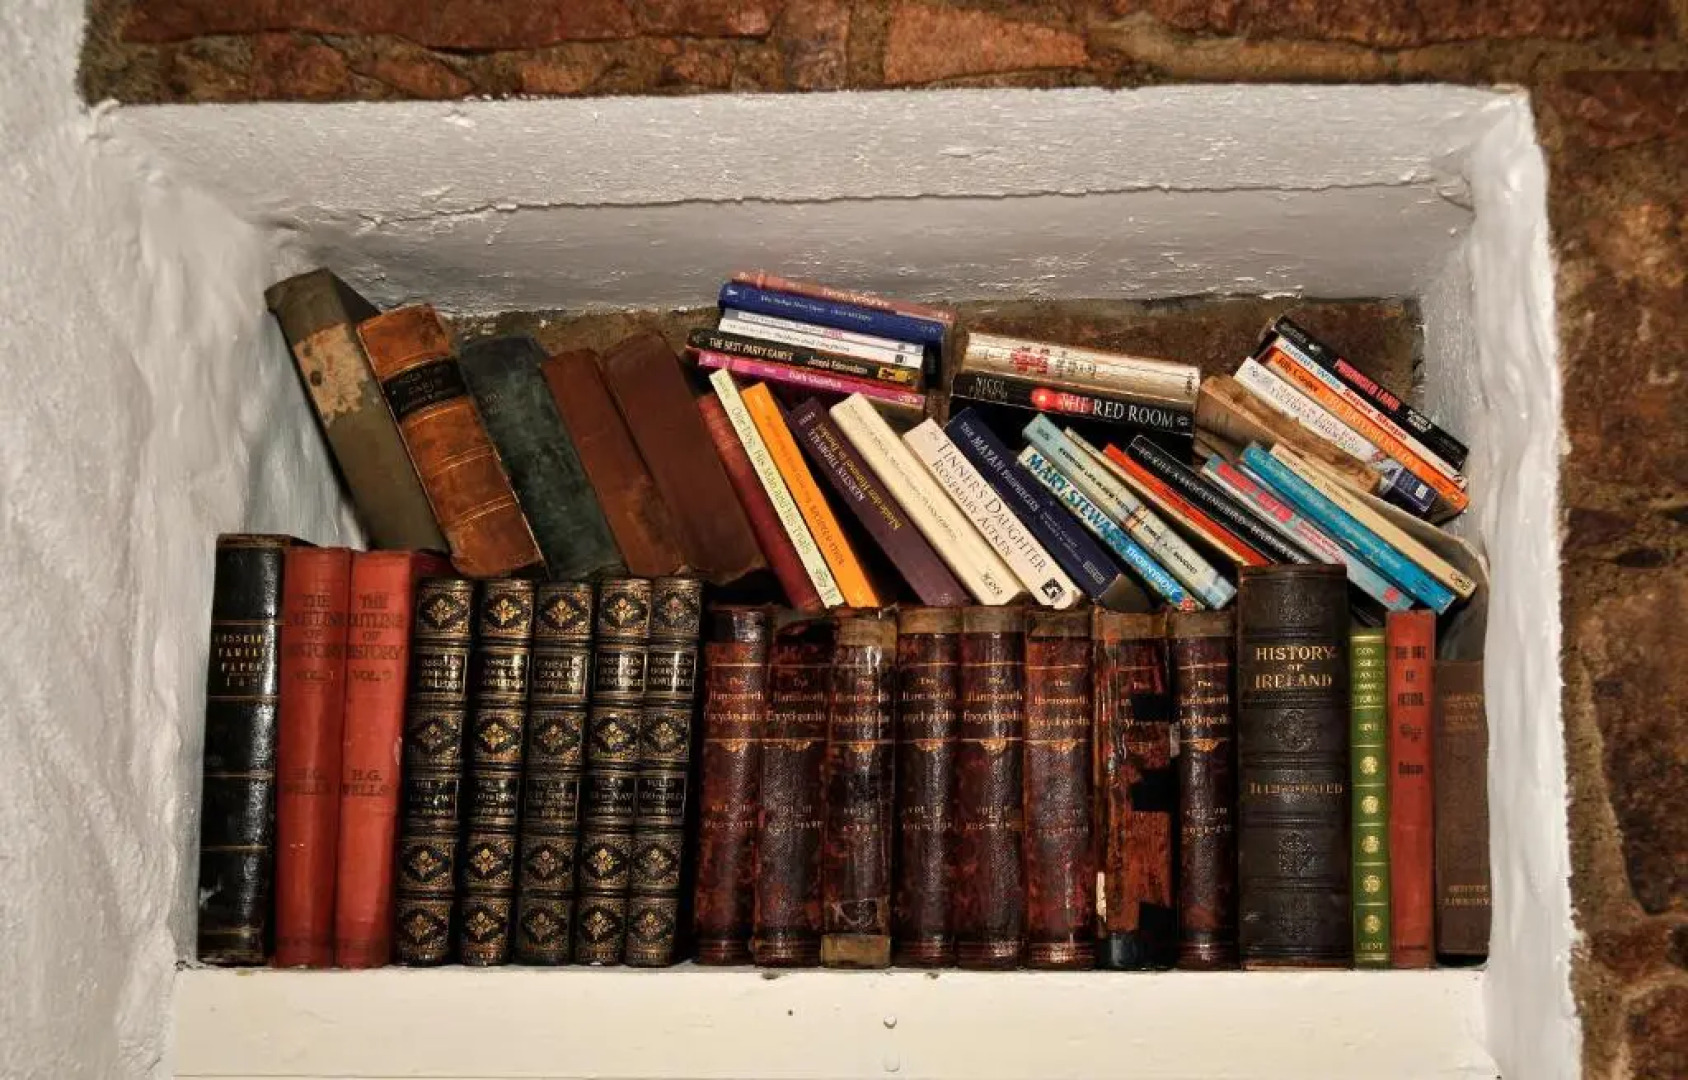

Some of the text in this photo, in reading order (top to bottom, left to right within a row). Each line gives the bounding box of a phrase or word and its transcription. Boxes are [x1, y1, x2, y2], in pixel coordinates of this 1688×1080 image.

[709, 337, 722, 348] THE
[723, 340, 742, 352] BEST
[742, 343, 767, 357] PARTY
[1059, 392, 1176, 428] THE RED ROOM
[1341, 387, 1375, 416] Super
[805, 426, 840, 469] THORVALL
[969, 433, 1006, 474] MAYAN
[1083, 469, 1098, 483] LIFE
[1137, 446, 1153, 461] TO
[1150, 455, 1172, 474] KILL
[1176, 474, 1248, 526] MOCKINGBIRD
[934, 438, 992, 502] TINNER'S
[982, 495, 1051, 573] DAUGHTER
[1023, 451, 1069, 494] MARY
[1062, 487, 1131, 550] STEWART
[346, 612, 404, 627] OUTLINE
[362, 631, 382, 641] OF
[346, 644, 404, 659] HISTORY
[1256, 646, 1335, 661] HISTORY
[1255, 674, 1333, 689] IRELAND
[1250, 783, 1343, 795] ILLUSTRATED
